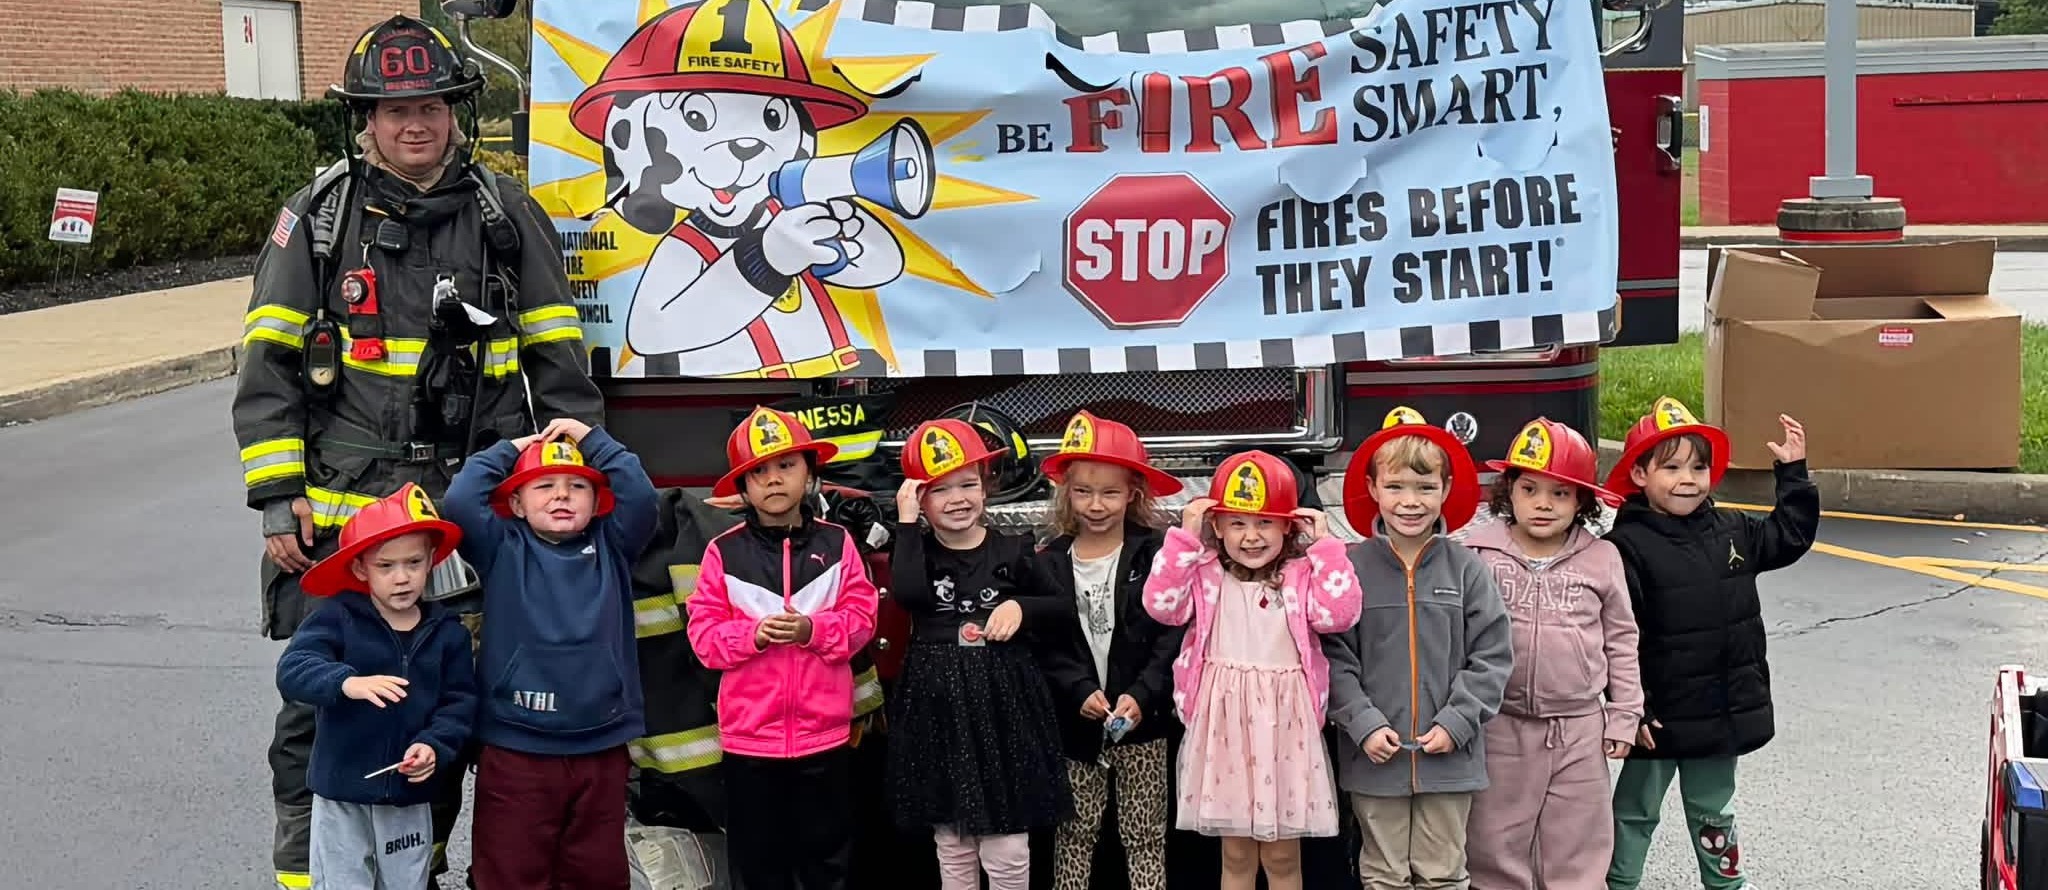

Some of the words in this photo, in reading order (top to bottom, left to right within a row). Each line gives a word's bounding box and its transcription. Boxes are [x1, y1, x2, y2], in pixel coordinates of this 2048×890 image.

[709, 0, 752, 53] 1
[1350, 0, 1552, 73] SAFETY
[381, 46, 430, 76] 60
[688, 56, 720, 68] FIRE
[724, 57, 780, 73] SAFETY
[997, 124, 1053, 153] BE
[1062, 41, 1338, 153] FIRE
[1353, 62, 1561, 142] SMART,
[1257, 191, 1388, 251] FIRES
[1408, 173, 1582, 238] BEFORE
[566, 256, 584, 274] IRE
[1076, 219, 1226, 281] STOP
[570, 280, 599, 299] AFETY
[1256, 256, 1372, 315] THEY
[1392, 240, 1553, 303] START!
[579, 304, 613, 323] UNCIL
[788, 404, 865, 430] NESSA
[1492, 561, 1584, 611] GAP
[385, 832, 425, 855] BRUH.
